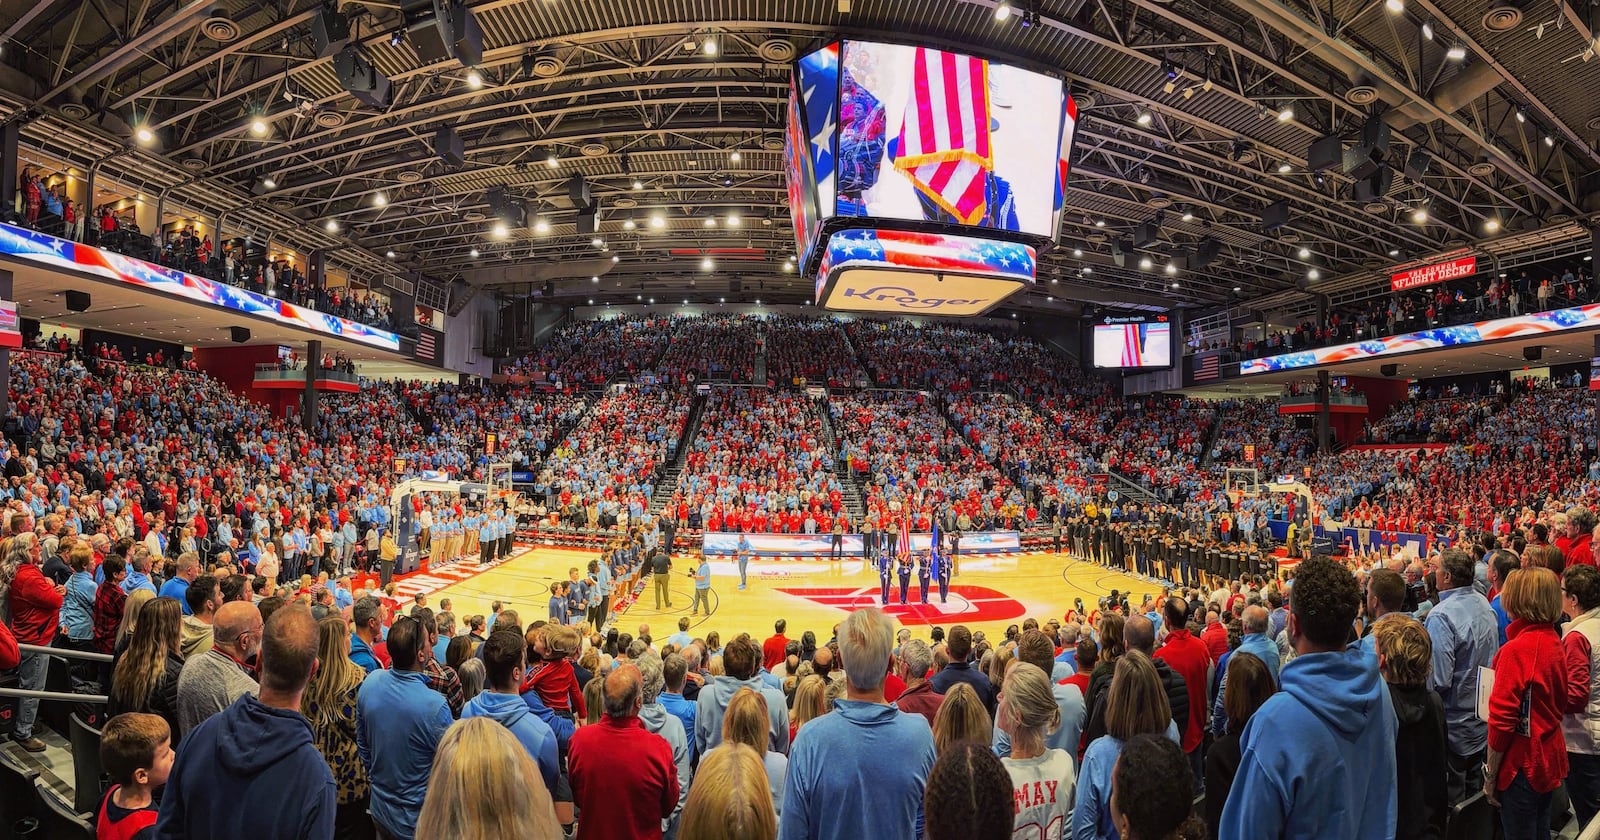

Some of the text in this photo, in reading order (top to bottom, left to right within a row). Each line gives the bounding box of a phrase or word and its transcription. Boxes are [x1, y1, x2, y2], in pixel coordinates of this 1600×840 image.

[1399, 265, 1467, 288] FLIGHT DECK
[1409, 263, 1457, 277] THE CONNOR
[844, 286, 990, 309] Kroger
[1014, 780, 1058, 815] MAY
